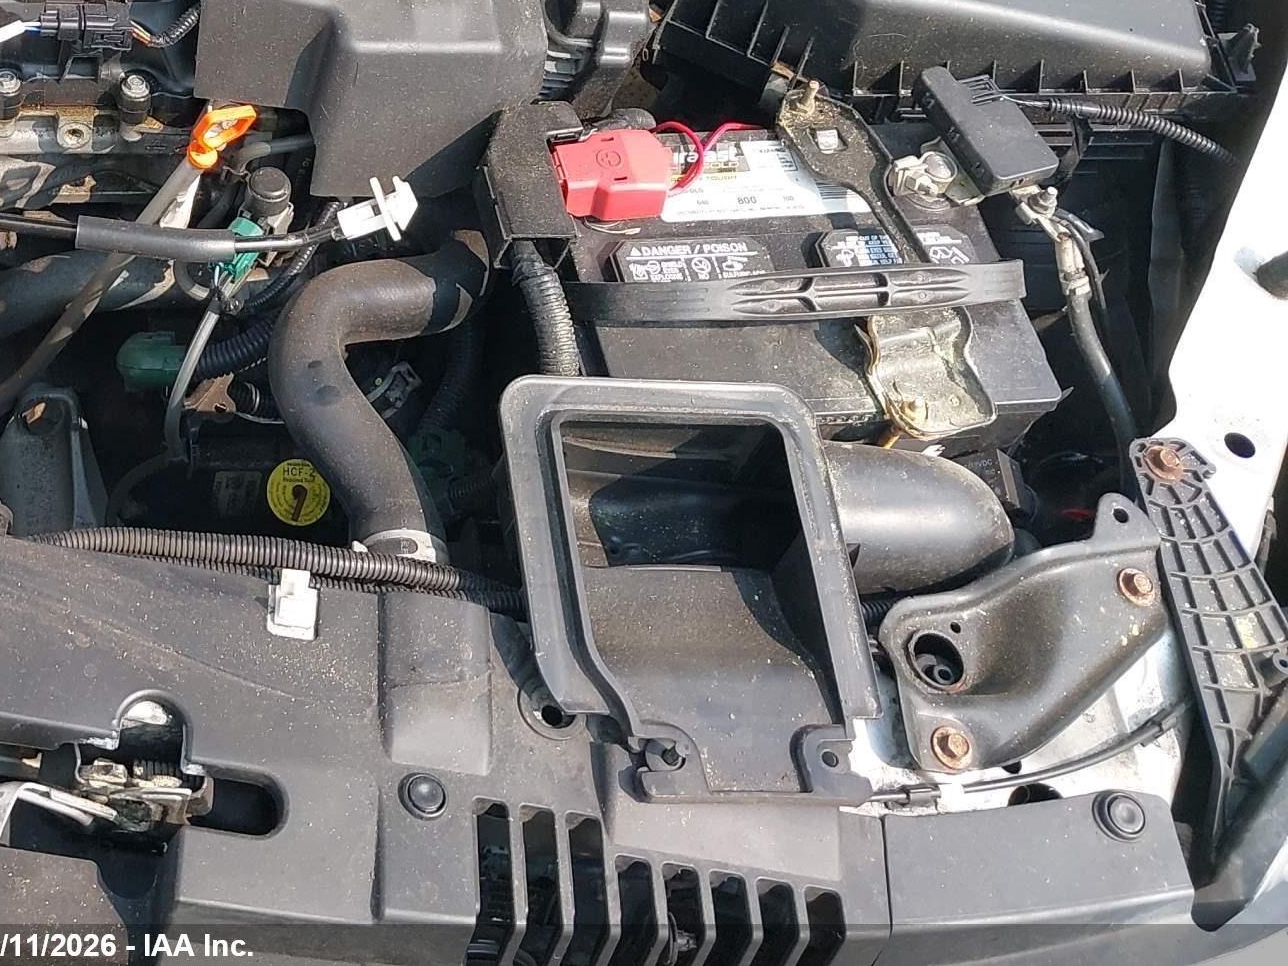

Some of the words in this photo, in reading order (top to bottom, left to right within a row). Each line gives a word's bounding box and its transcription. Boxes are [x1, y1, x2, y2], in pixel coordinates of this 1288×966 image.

[737, 196, 757, 205] 800
[640, 244, 691, 256] DANGER
[703, 242, 749, 253] POISON
